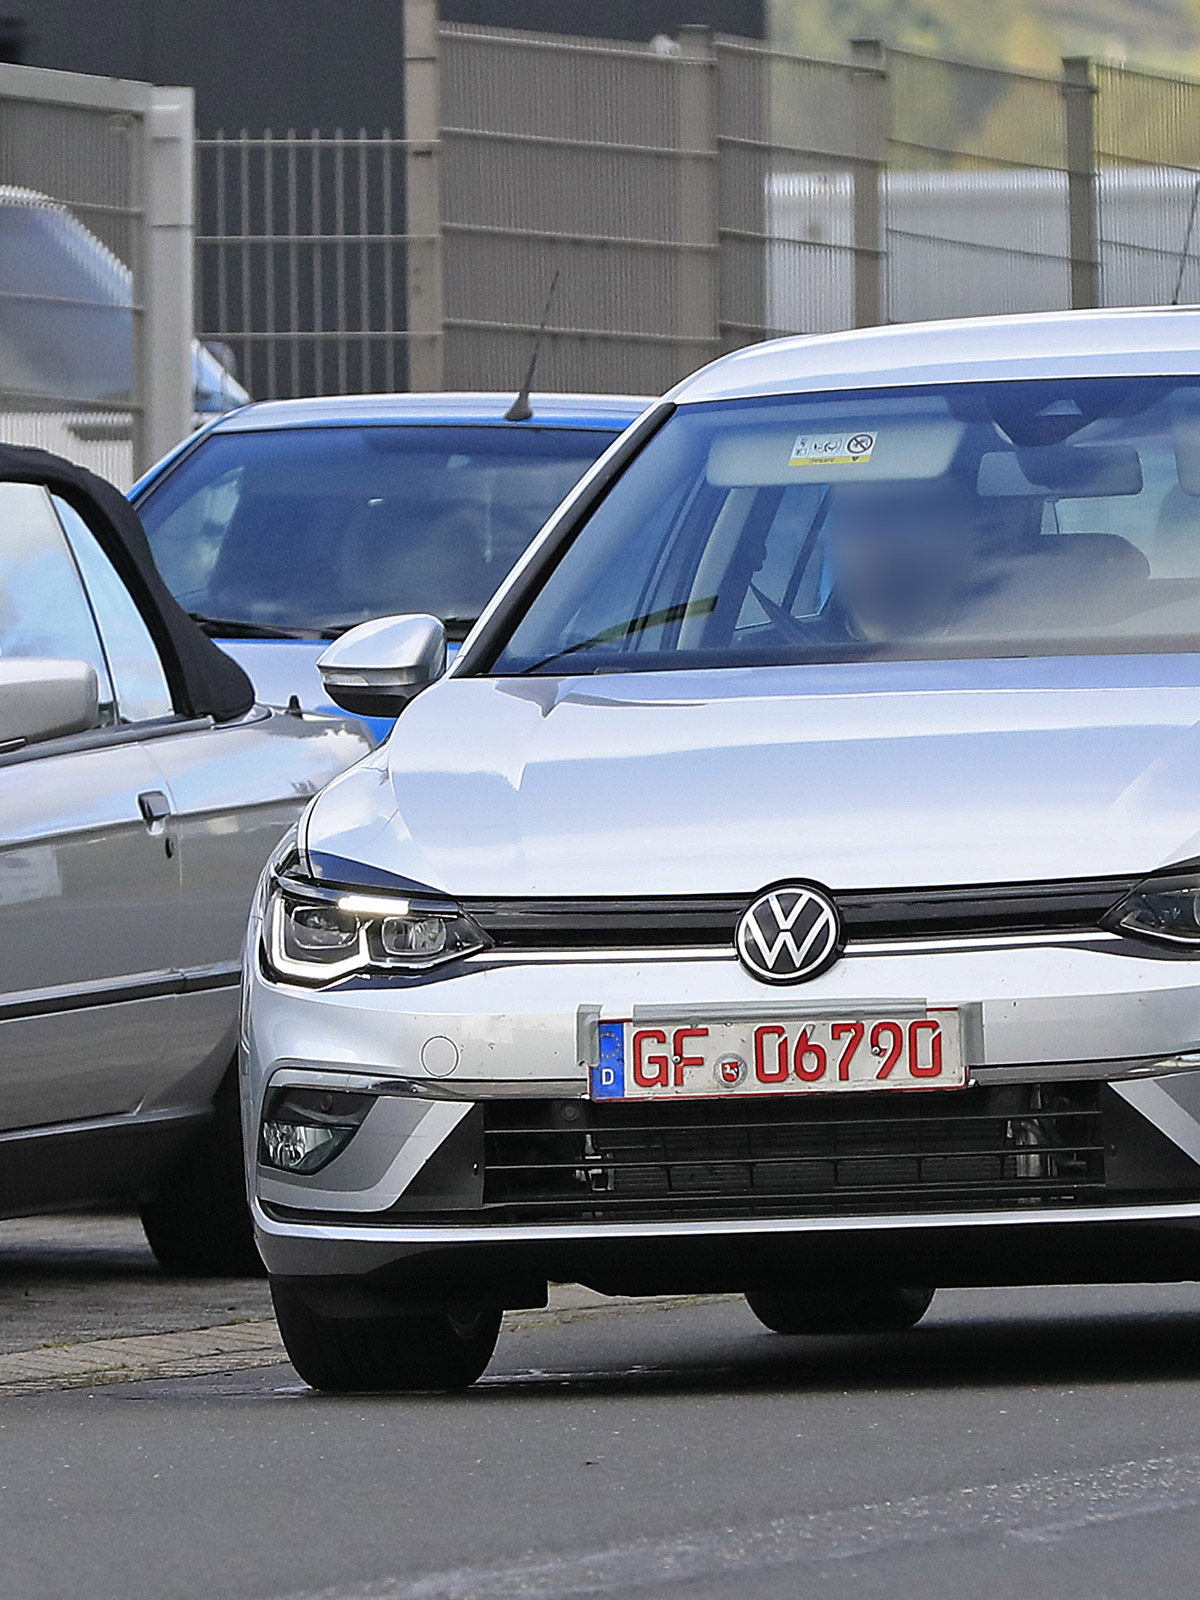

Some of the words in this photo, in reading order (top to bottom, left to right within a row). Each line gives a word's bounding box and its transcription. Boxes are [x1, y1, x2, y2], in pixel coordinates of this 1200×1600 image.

[742, 891, 832, 972] VW
[602, 1068, 615, 1085] D
[633, 1028, 709, 1087] GF
[754, 1020, 942, 1083] 06790
